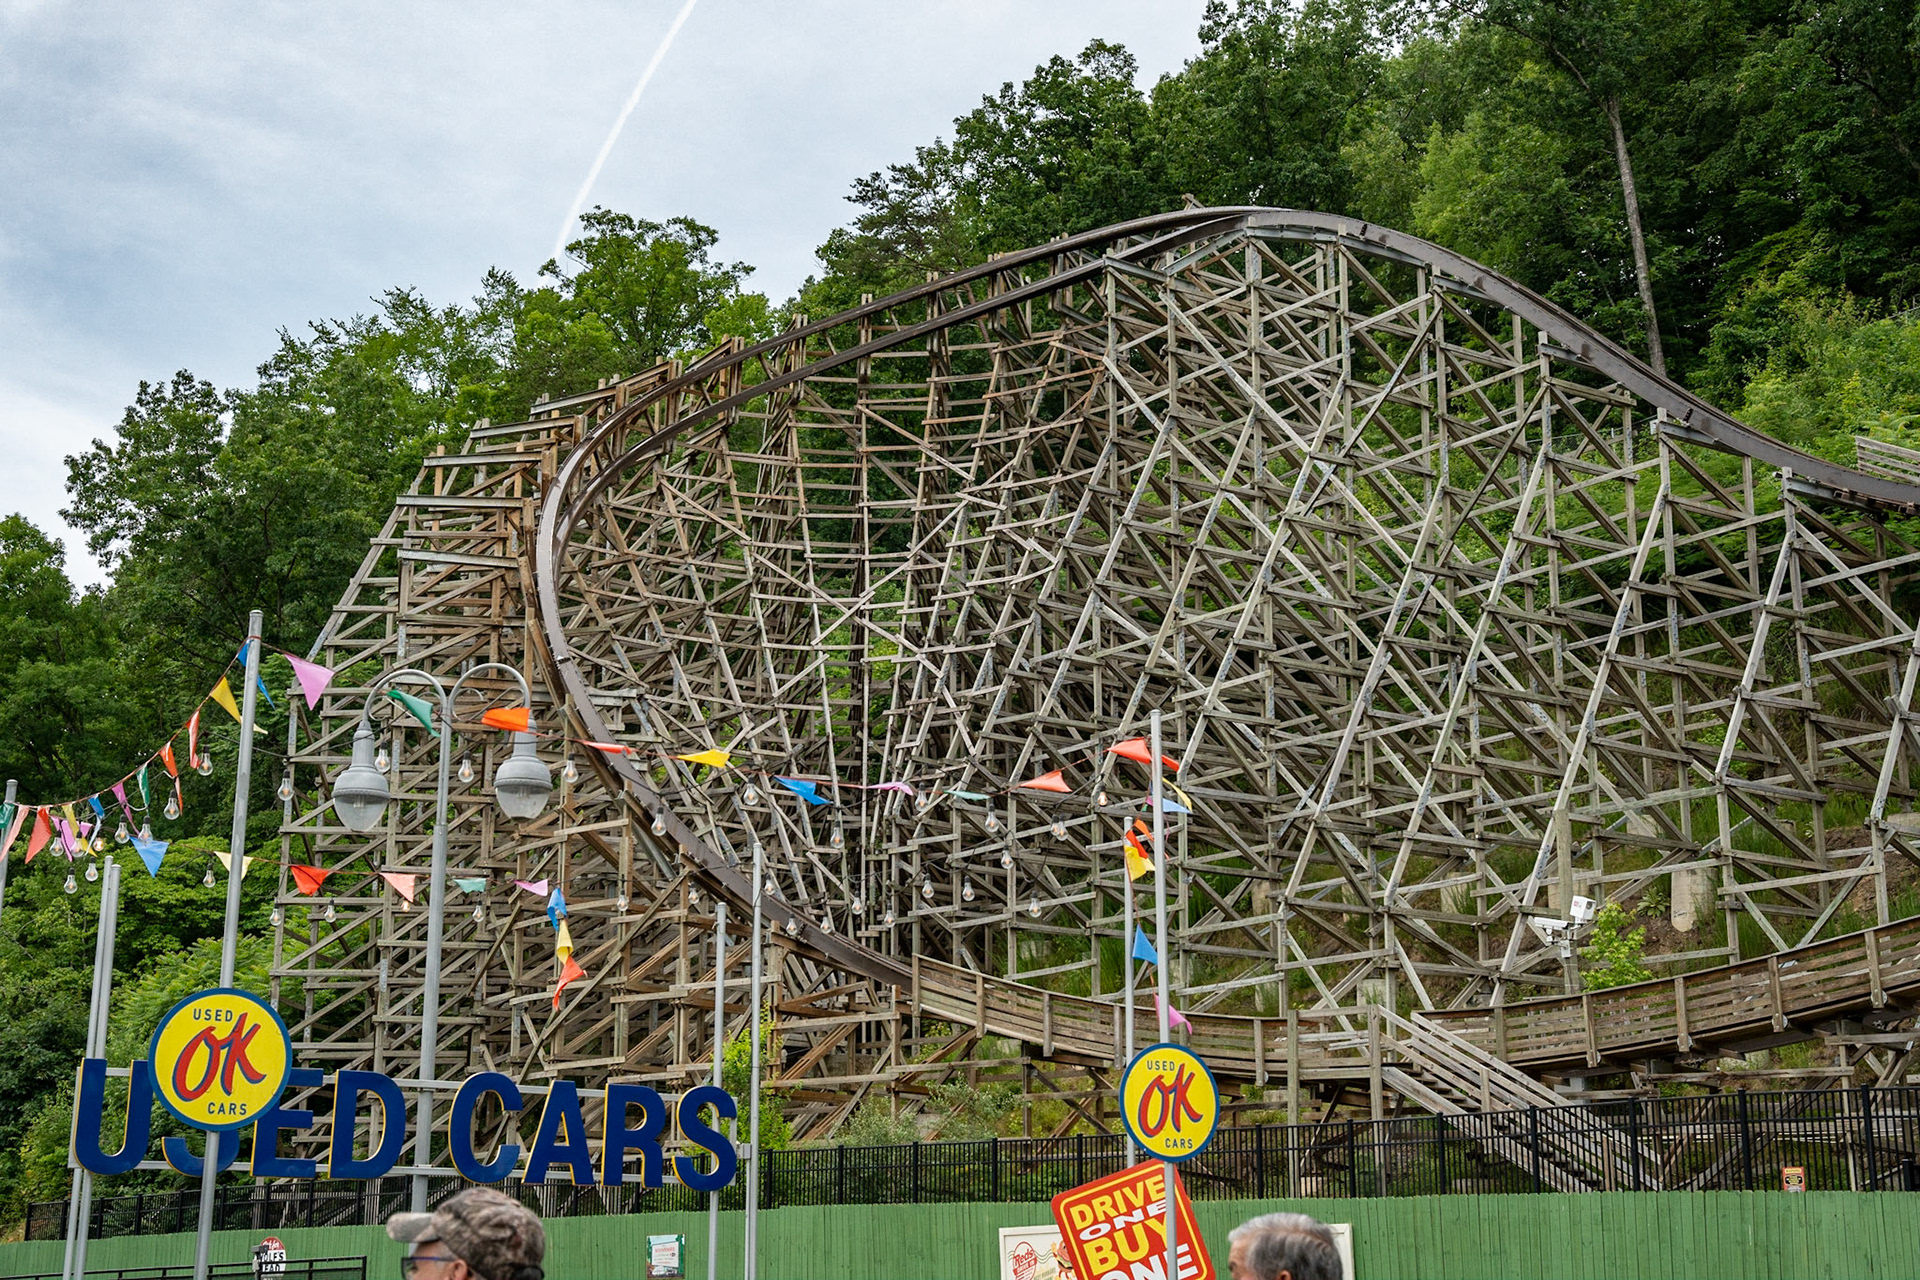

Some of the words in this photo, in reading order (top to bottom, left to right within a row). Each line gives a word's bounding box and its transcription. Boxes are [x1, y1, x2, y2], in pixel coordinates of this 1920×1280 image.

[193, 1008, 233, 1022] USED
[172, 1012, 267, 1102] OK
[1147, 1060, 1175, 1071] USED
[207, 1102, 247, 1116] CARS
[1138, 1063, 1203, 1138] OK
[448, 1071, 738, 1192] CARS
[1165, 1138, 1193, 1149] CARS
[1069, 1174, 1166, 1230] DRIVE
[1079, 1200, 1167, 1241] ONE
[1013, 1248, 1034, 1267] Reds
